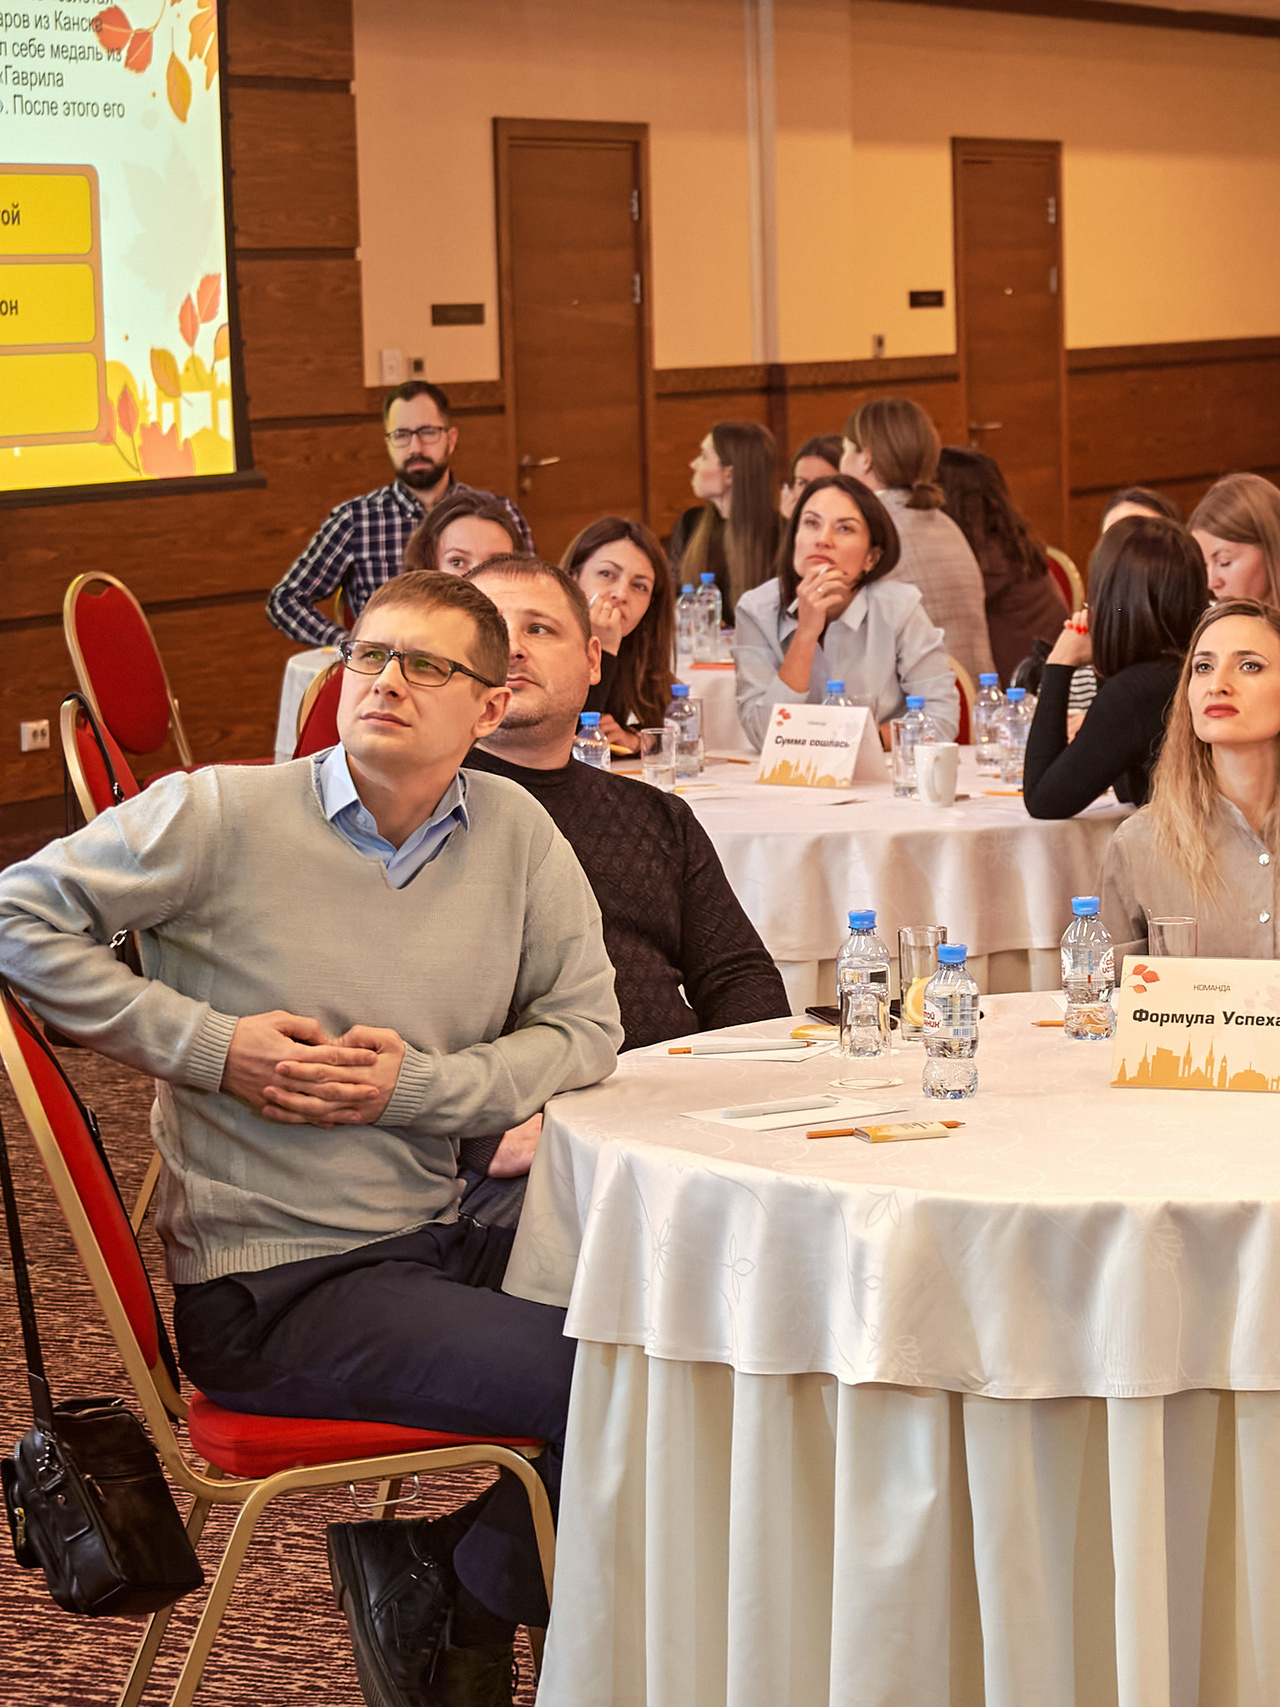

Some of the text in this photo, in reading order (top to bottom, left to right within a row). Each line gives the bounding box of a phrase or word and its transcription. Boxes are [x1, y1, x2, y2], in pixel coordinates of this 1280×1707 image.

[34, 14, 50, 30] из
[54, 10, 103, 33] Канска
[12, 37, 45, 58] себе
[50, 43, 103, 63] медаль
[107, 47, 122, 62] из
[13, 94, 58, 116] После
[63, 101, 99, 117] этого
[103, 102, 125, 118] его
[0, 202, 20, 226] ой
[775, 735, 850, 748] Сумма сошлась
[1132, 1008, 1215, 1027] Формула
